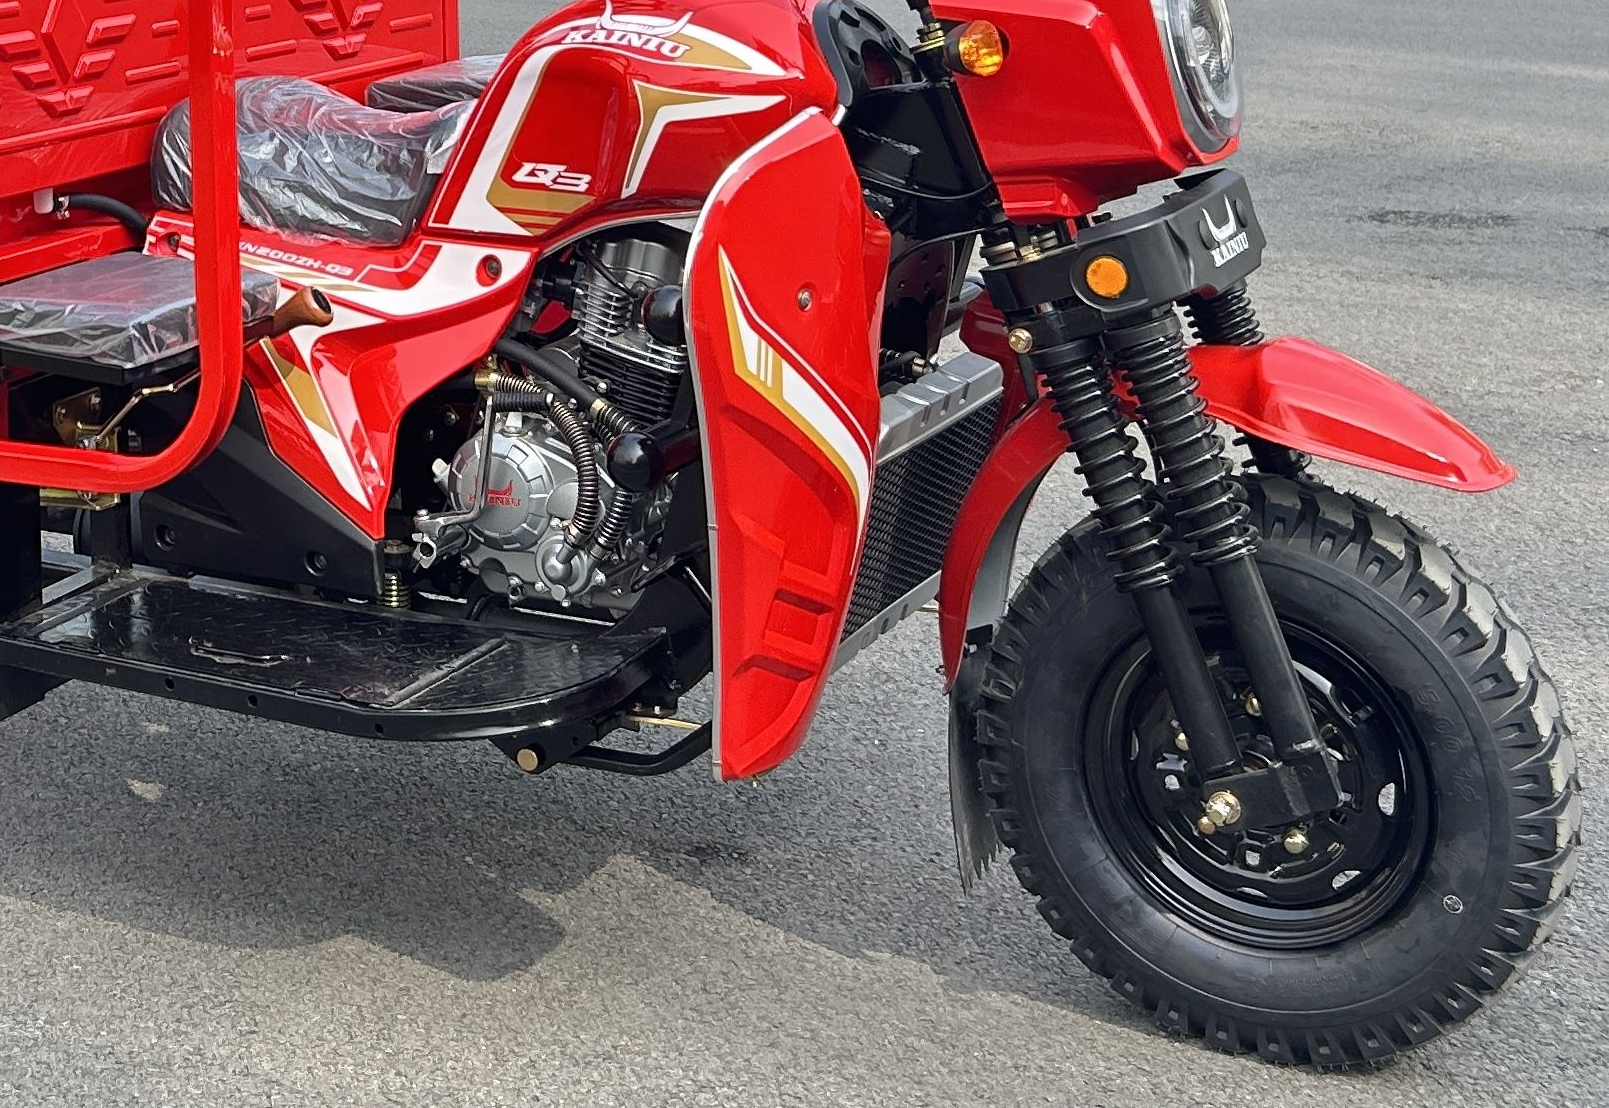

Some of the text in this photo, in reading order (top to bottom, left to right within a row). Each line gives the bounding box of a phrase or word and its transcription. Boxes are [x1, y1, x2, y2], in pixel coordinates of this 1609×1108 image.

[560, 29, 692, 59] KAINIU
[511, 161, 592, 192] Q3
[1210, 231, 1249, 268] KAINIU
